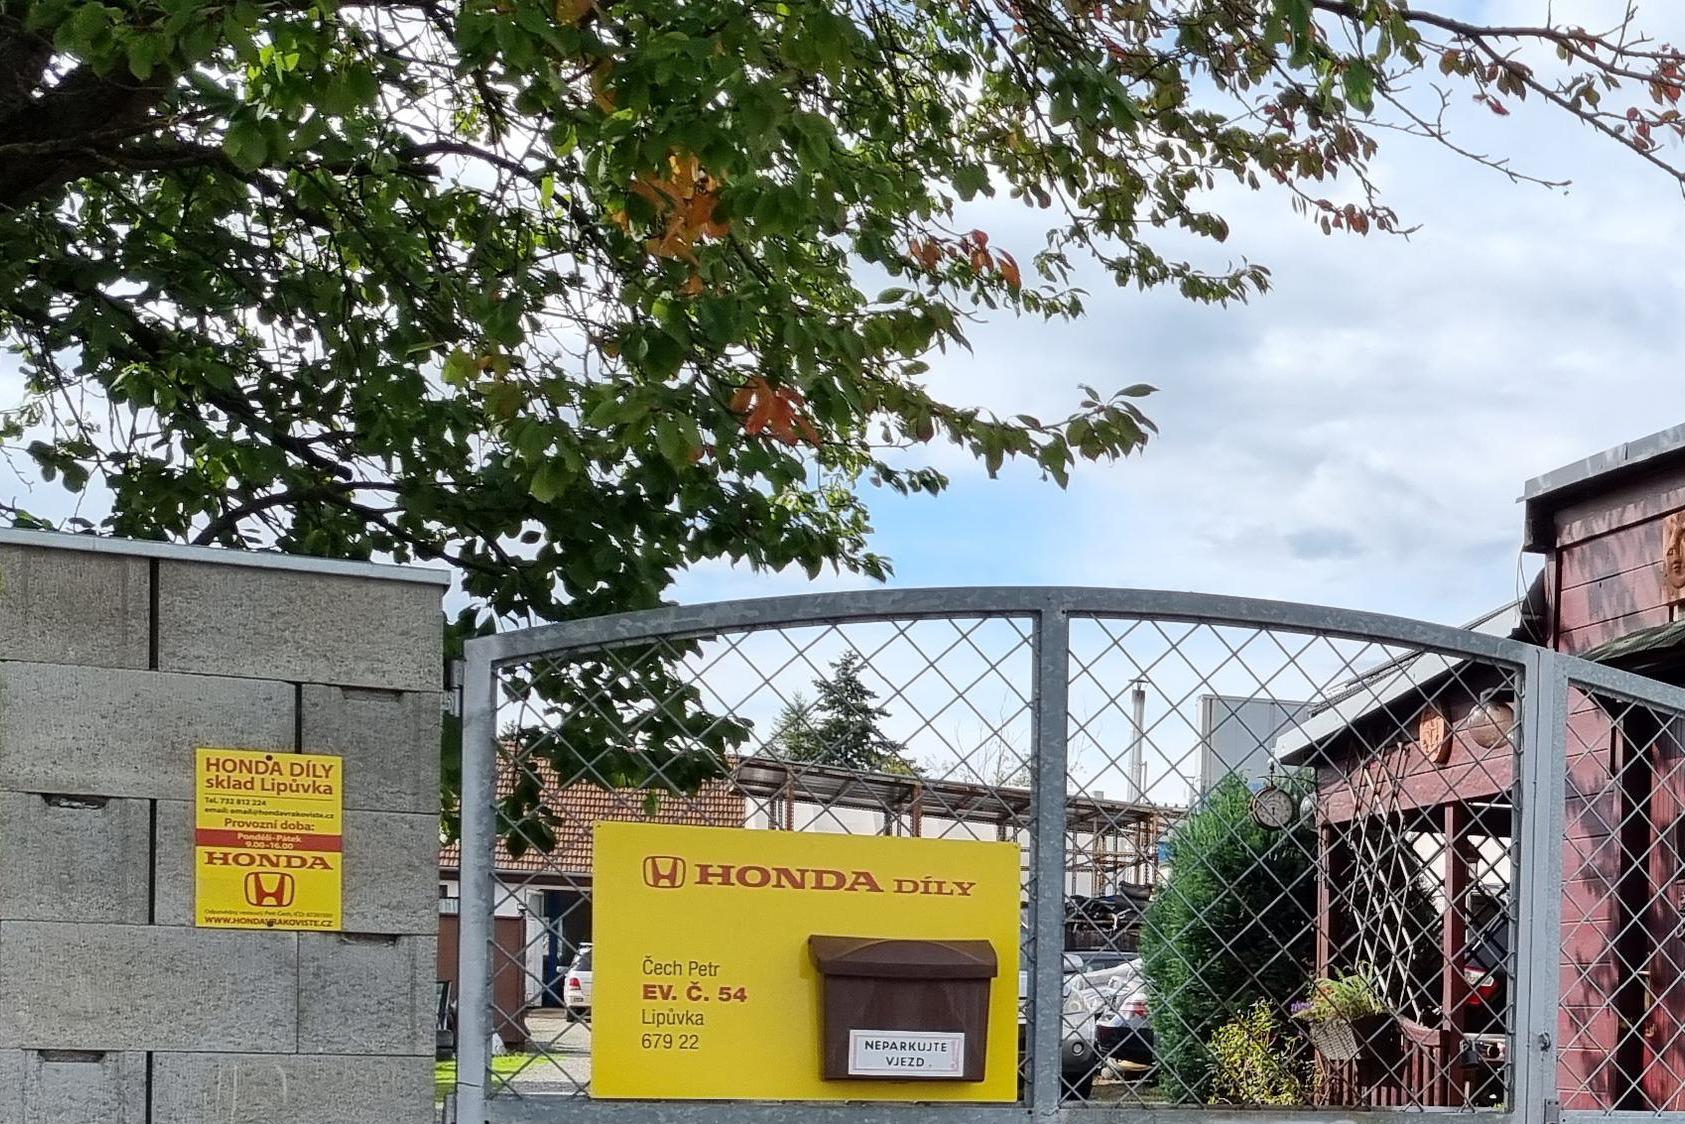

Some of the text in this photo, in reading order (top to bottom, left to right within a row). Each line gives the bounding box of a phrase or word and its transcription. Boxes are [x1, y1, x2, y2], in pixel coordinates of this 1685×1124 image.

[206, 757, 334, 779] HONDA DÍLY
[205, 775, 333, 795] sklad Lipůvka
[224, 817, 315, 831] Provozní doba:
[204, 851, 333, 870] HONDA
[694, 864, 884, 893] HONDA
[893, 876, 976, 896] DÍLY
[642, 956, 720, 978] Čech Petr
[642, 981, 748, 1003] EV. Č. 54
[642, 1007, 705, 1028] Lipůvka
[642, 1033, 699, 1050] 679 22
[864, 1040, 948, 1052] NEPARKUJTE
[886, 1056, 925, 1067] VJEZD
